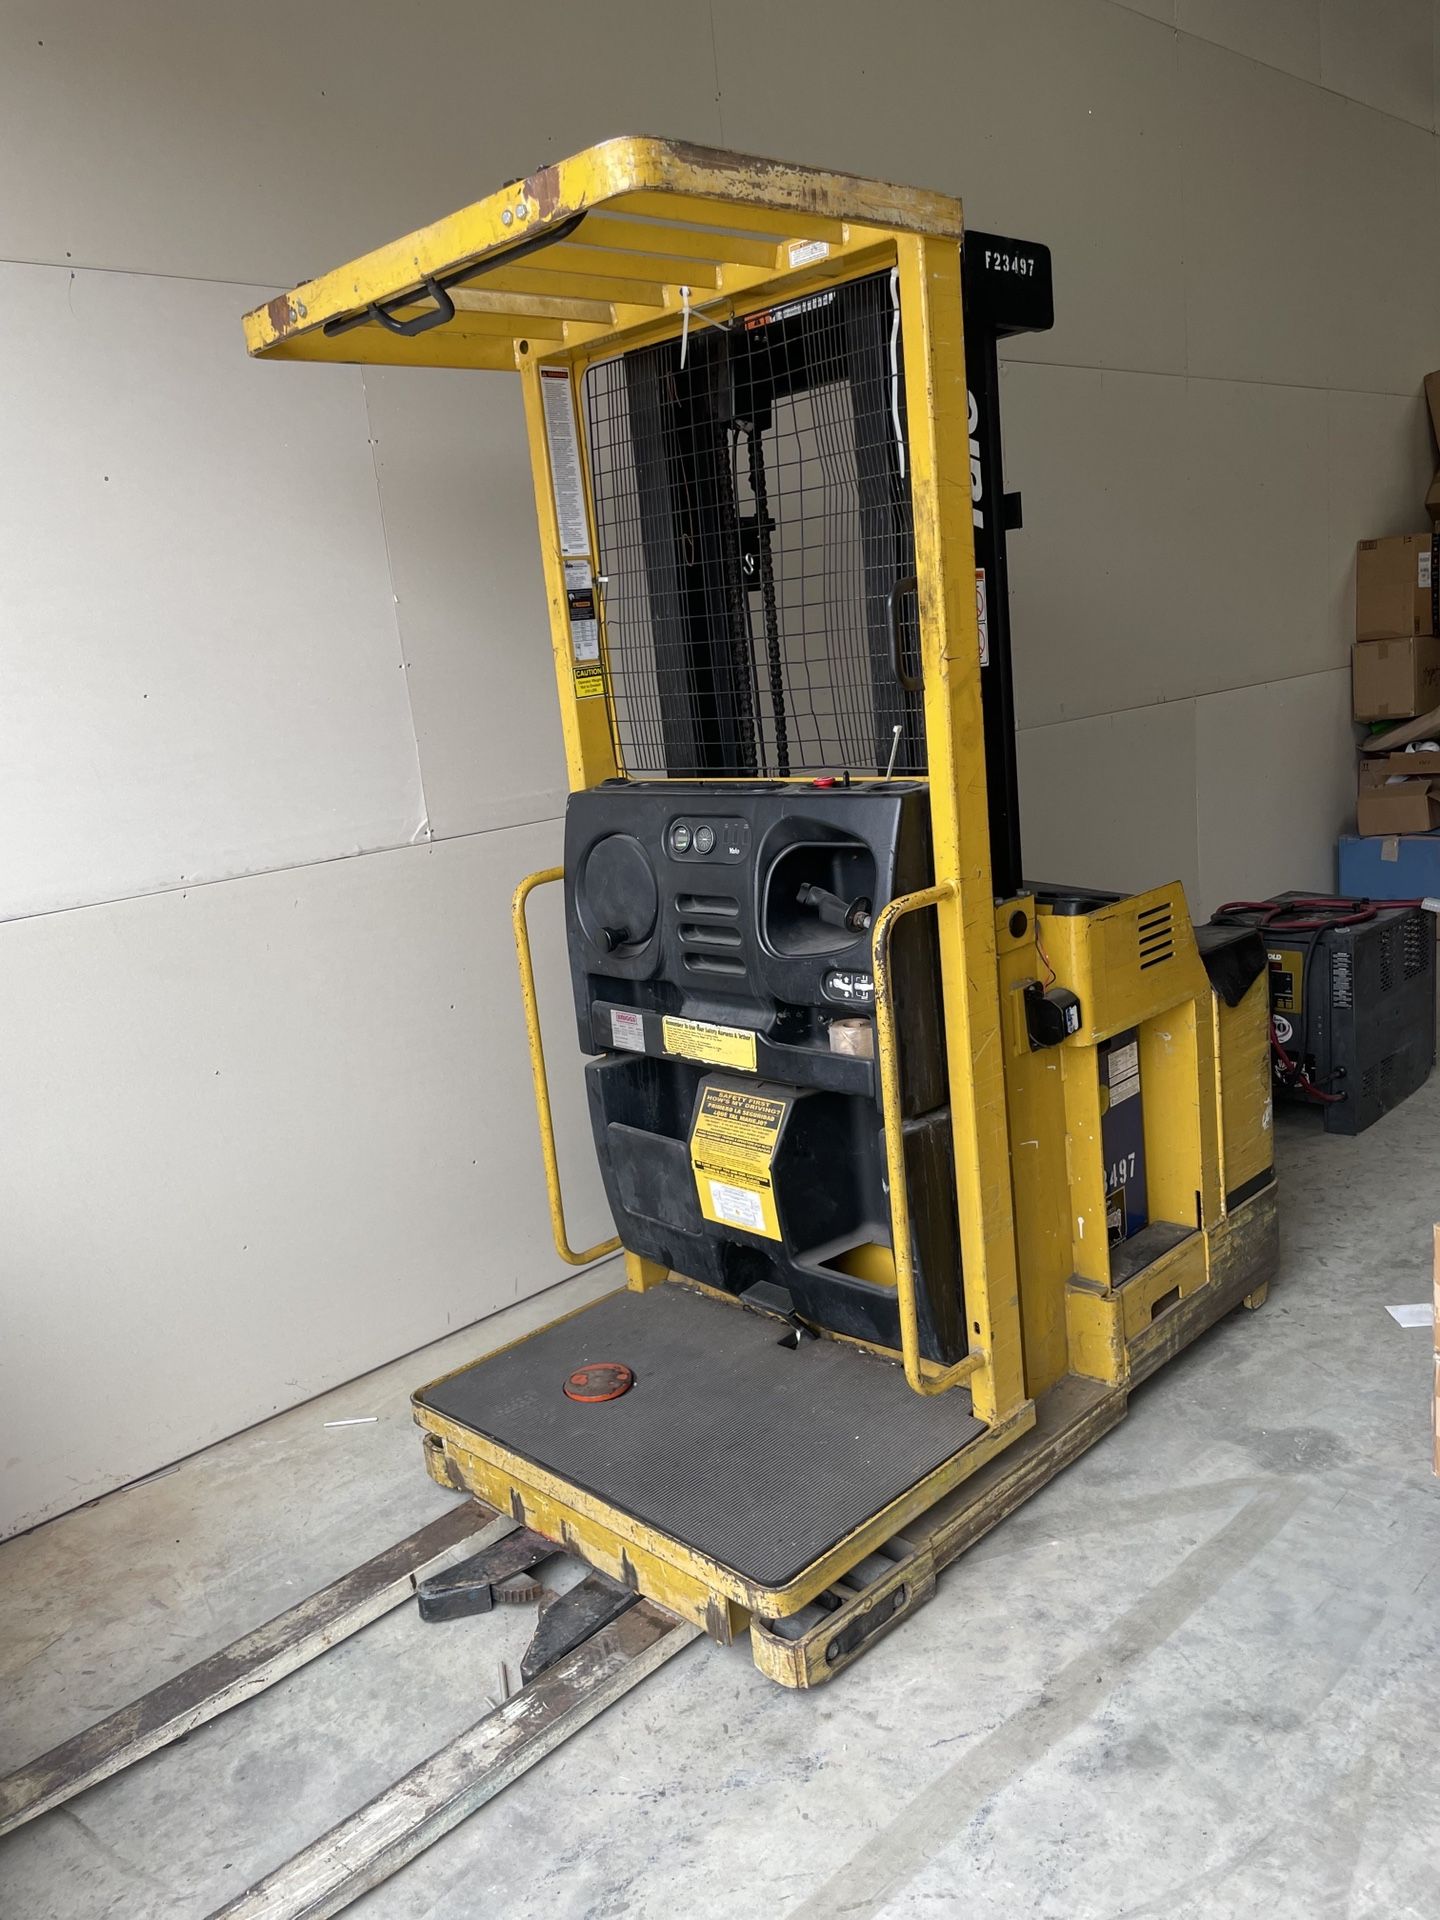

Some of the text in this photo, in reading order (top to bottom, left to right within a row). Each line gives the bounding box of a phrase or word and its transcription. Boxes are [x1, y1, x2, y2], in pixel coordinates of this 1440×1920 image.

[985, 251, 1034, 277] F23497
[576, 668, 602, 677] CAUTION
[707, 1095, 730, 1104] HOW'S
[744, 1103, 781, 1115] DRIVING?
[718, 1092, 771, 1107] SAFETY FIRST
[707, 1102, 733, 1113] PRIMERO
[742, 1110, 775, 1122] SEGURIDAD
[739, 1115, 768, 1126] MANEJO?
